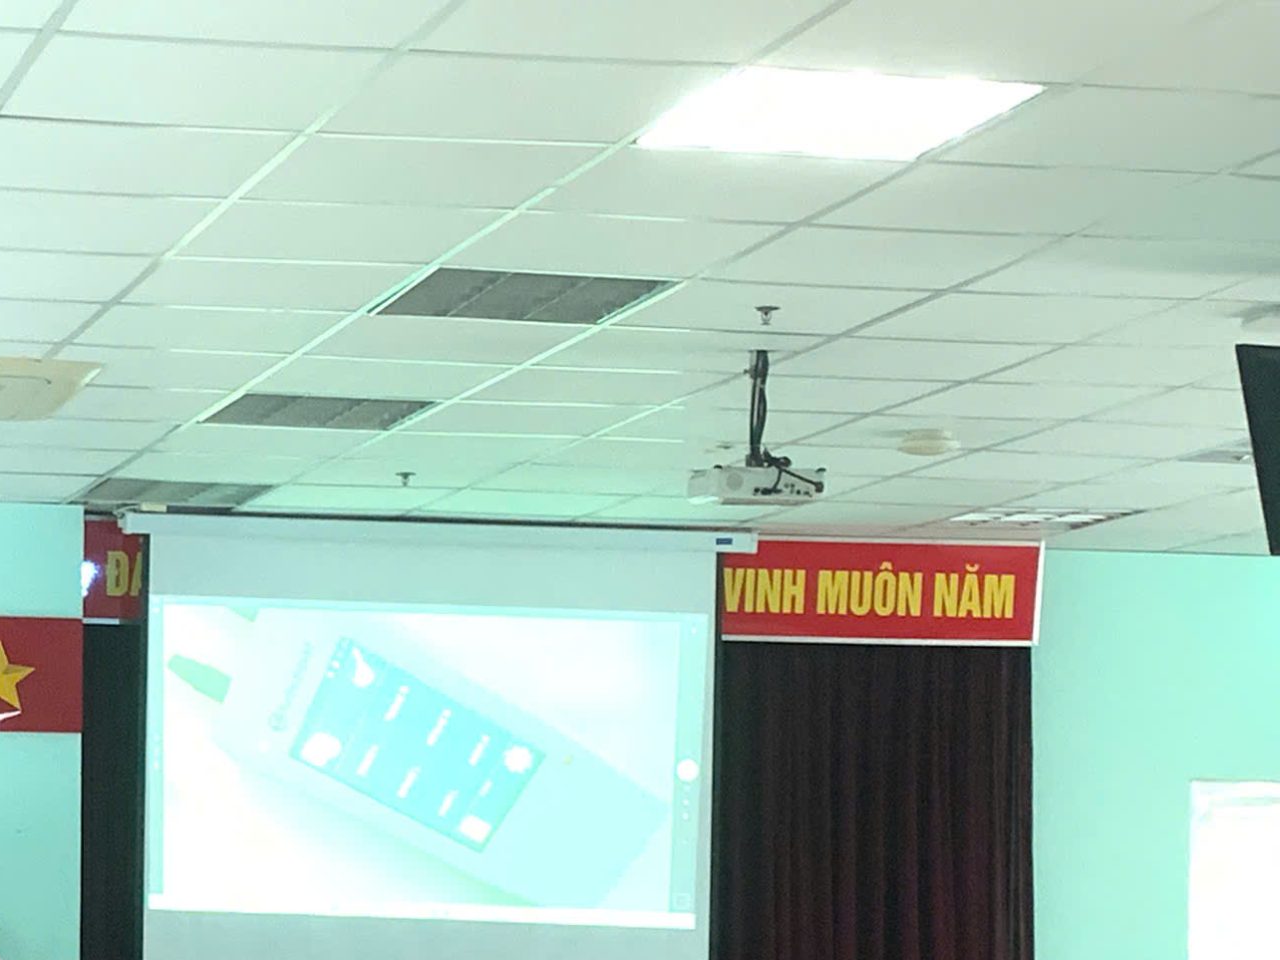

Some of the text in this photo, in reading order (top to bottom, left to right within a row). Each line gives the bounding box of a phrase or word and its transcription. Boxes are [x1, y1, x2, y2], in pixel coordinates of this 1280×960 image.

[723, 561, 1016, 619] VINH MUÔN NĂM
